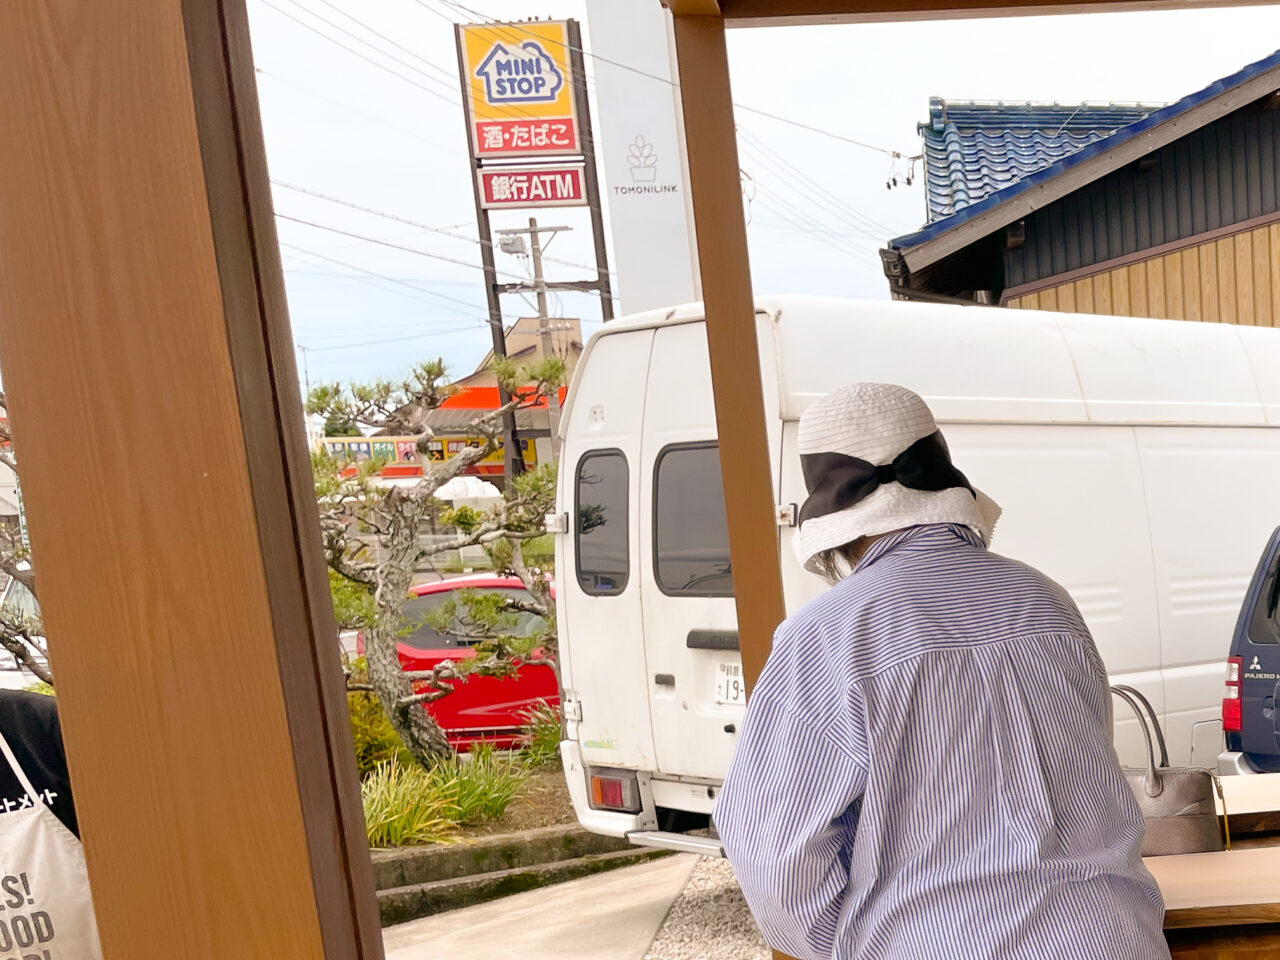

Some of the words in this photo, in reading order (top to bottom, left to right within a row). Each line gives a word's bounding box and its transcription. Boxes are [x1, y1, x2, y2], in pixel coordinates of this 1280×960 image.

[495, 57, 541, 75] MINI
[495, 77, 546, 96] STOP
[482, 123, 570, 149] 酒・たばこ
[490, 173, 574, 200] 銀行ATM
[613, 185, 678, 195] TOMONILINK
[1244, 672, 1276, 680] PAJERO
[0, 788, 58, 812] トメト
[0, 872, 35, 911] S!
